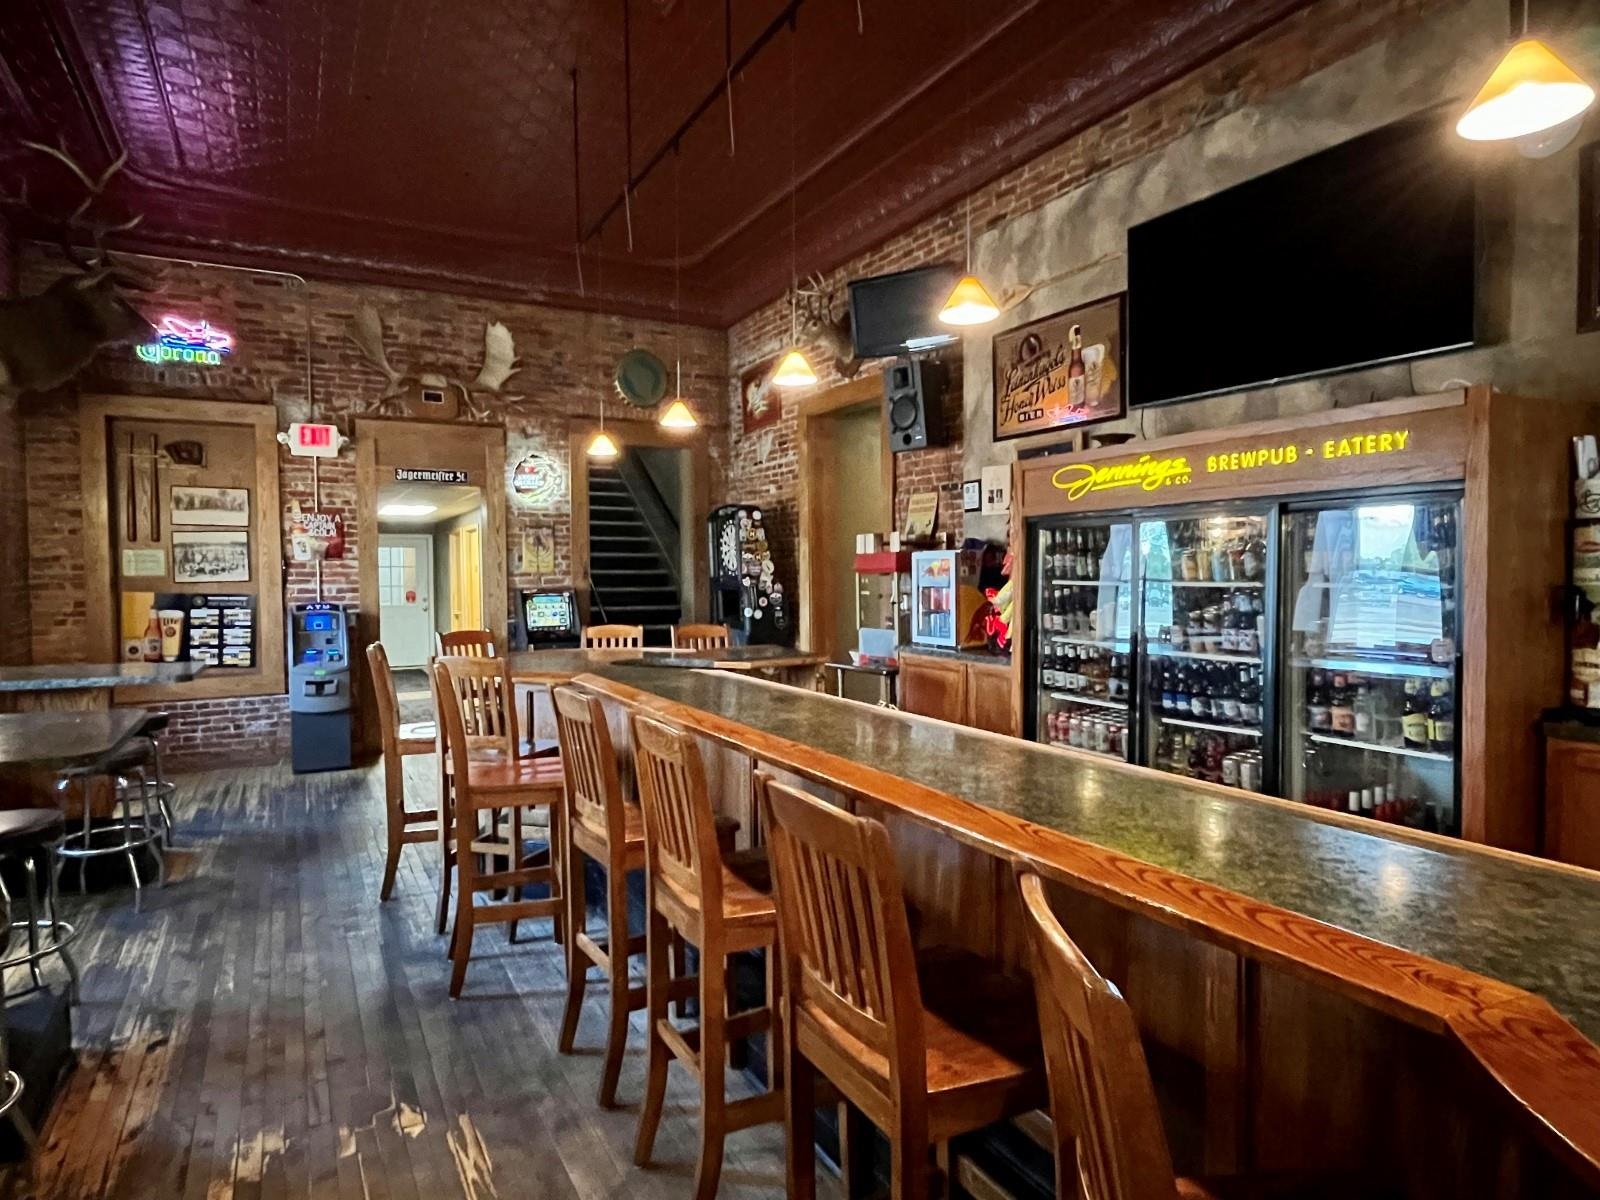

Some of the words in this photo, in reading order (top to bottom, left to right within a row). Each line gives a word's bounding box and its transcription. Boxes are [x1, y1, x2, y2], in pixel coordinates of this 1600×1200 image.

[136, 344, 221, 365] Corona
[300, 426, 332, 447] EXIT
[1206, 445, 1298, 473] BREWPUB
[1322, 431, 1409, 459] EATERY
[1052, 455, 1192, 501] Jennings
[302, 513, 333, 523] ENJOY
[334, 514, 341, 523] A
[304, 521, 336, 530] CAPTAIN
